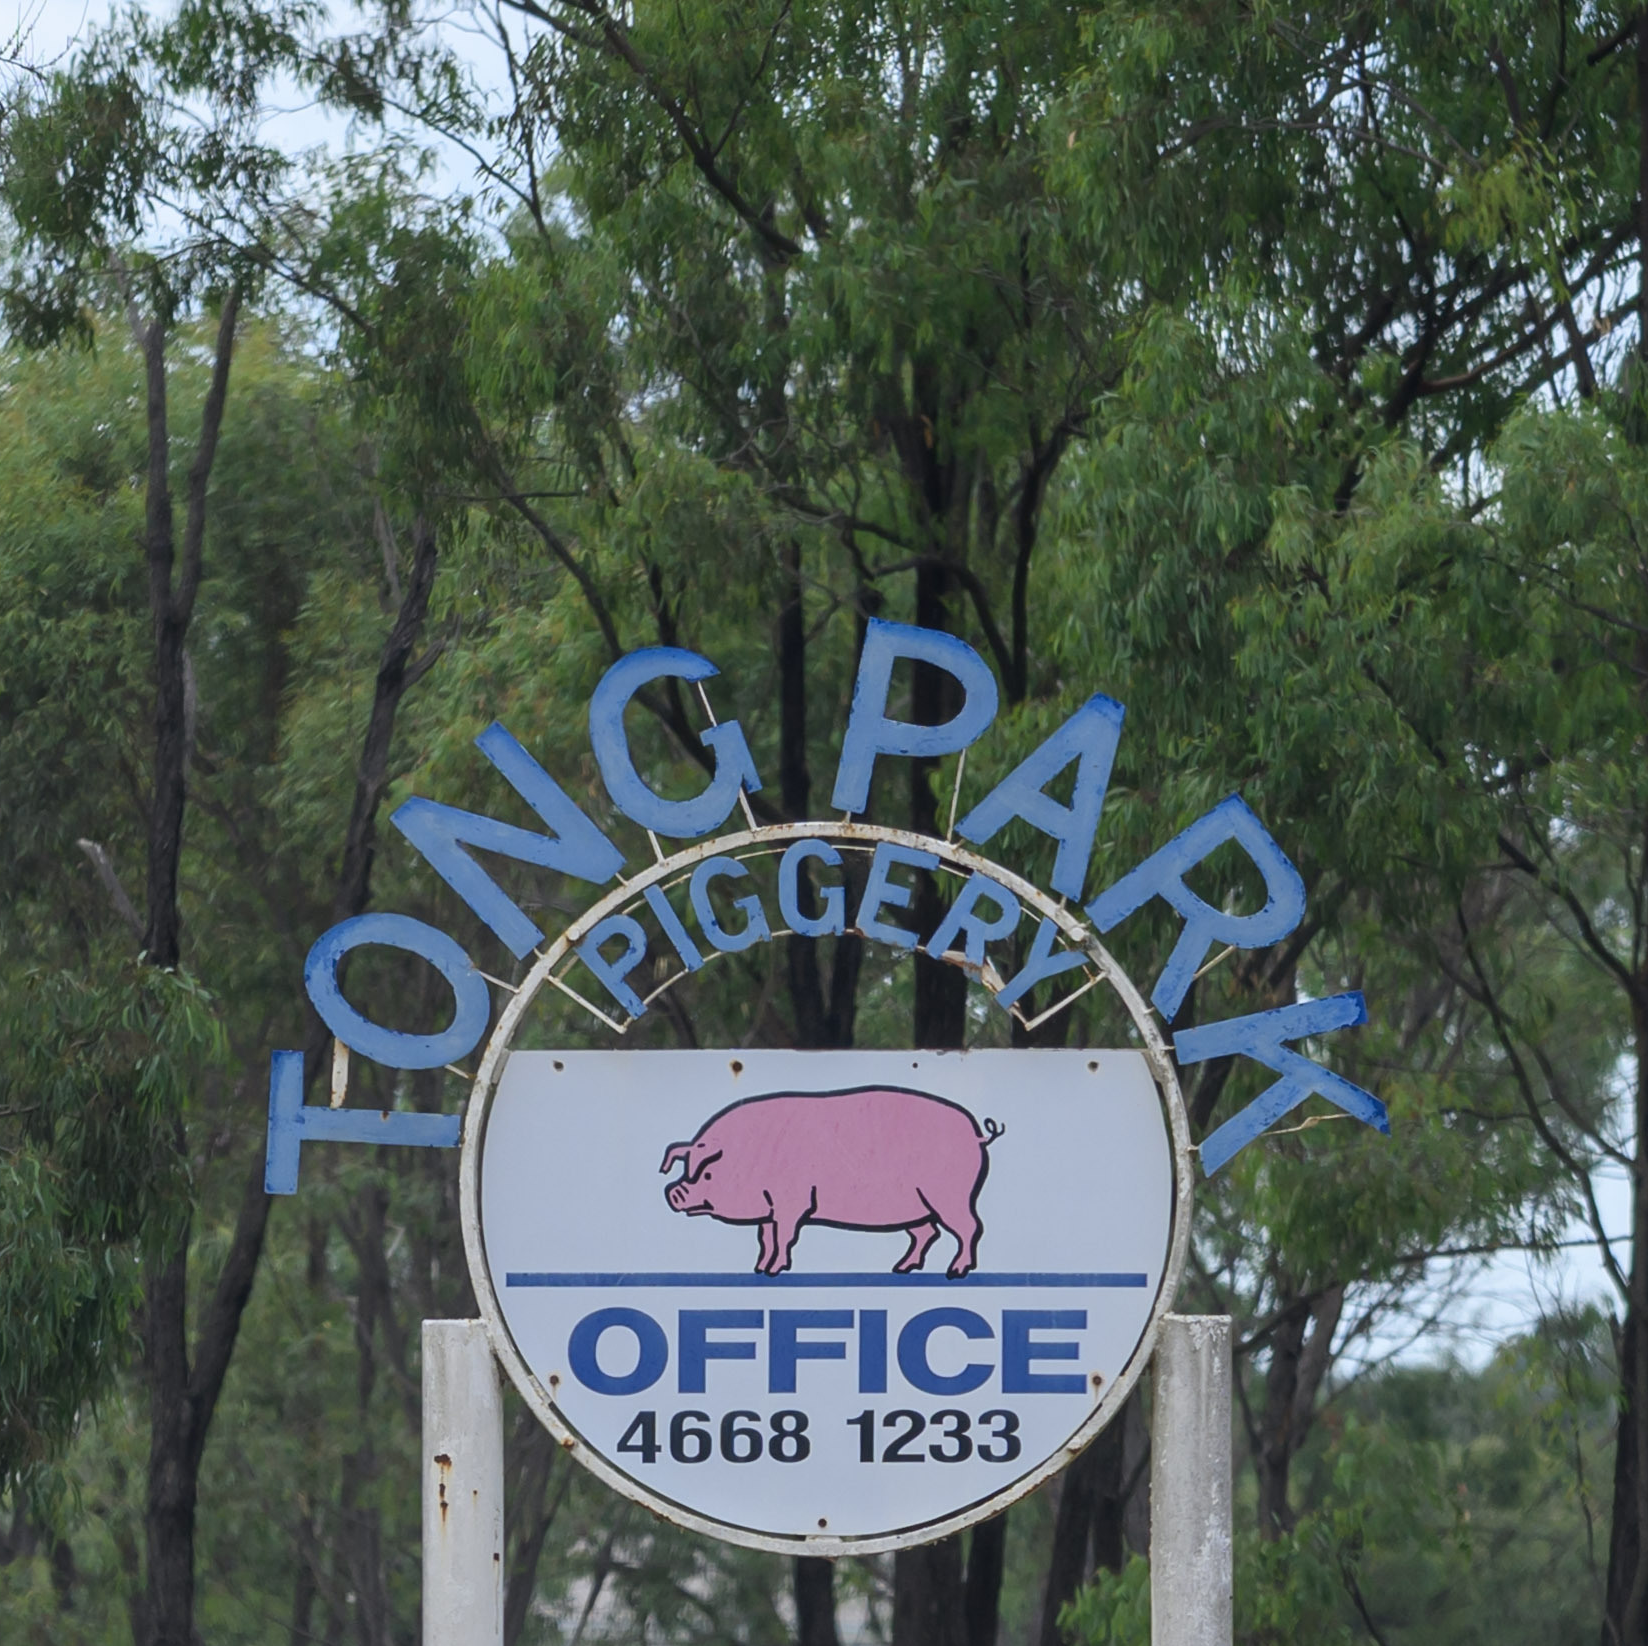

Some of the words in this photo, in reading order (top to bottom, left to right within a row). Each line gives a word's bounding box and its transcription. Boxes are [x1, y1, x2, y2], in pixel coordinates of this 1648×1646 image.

[264, 645, 762, 1194] TONG
[832, 617, 1390, 1177] PARK
[575, 839, 1090, 1018] PIGGERY
[567, 1306, 1089, 1396] OFFICE
[616, 1409, 811, 1464] 4668
[845, 1408, 1022, 1464] 1233
